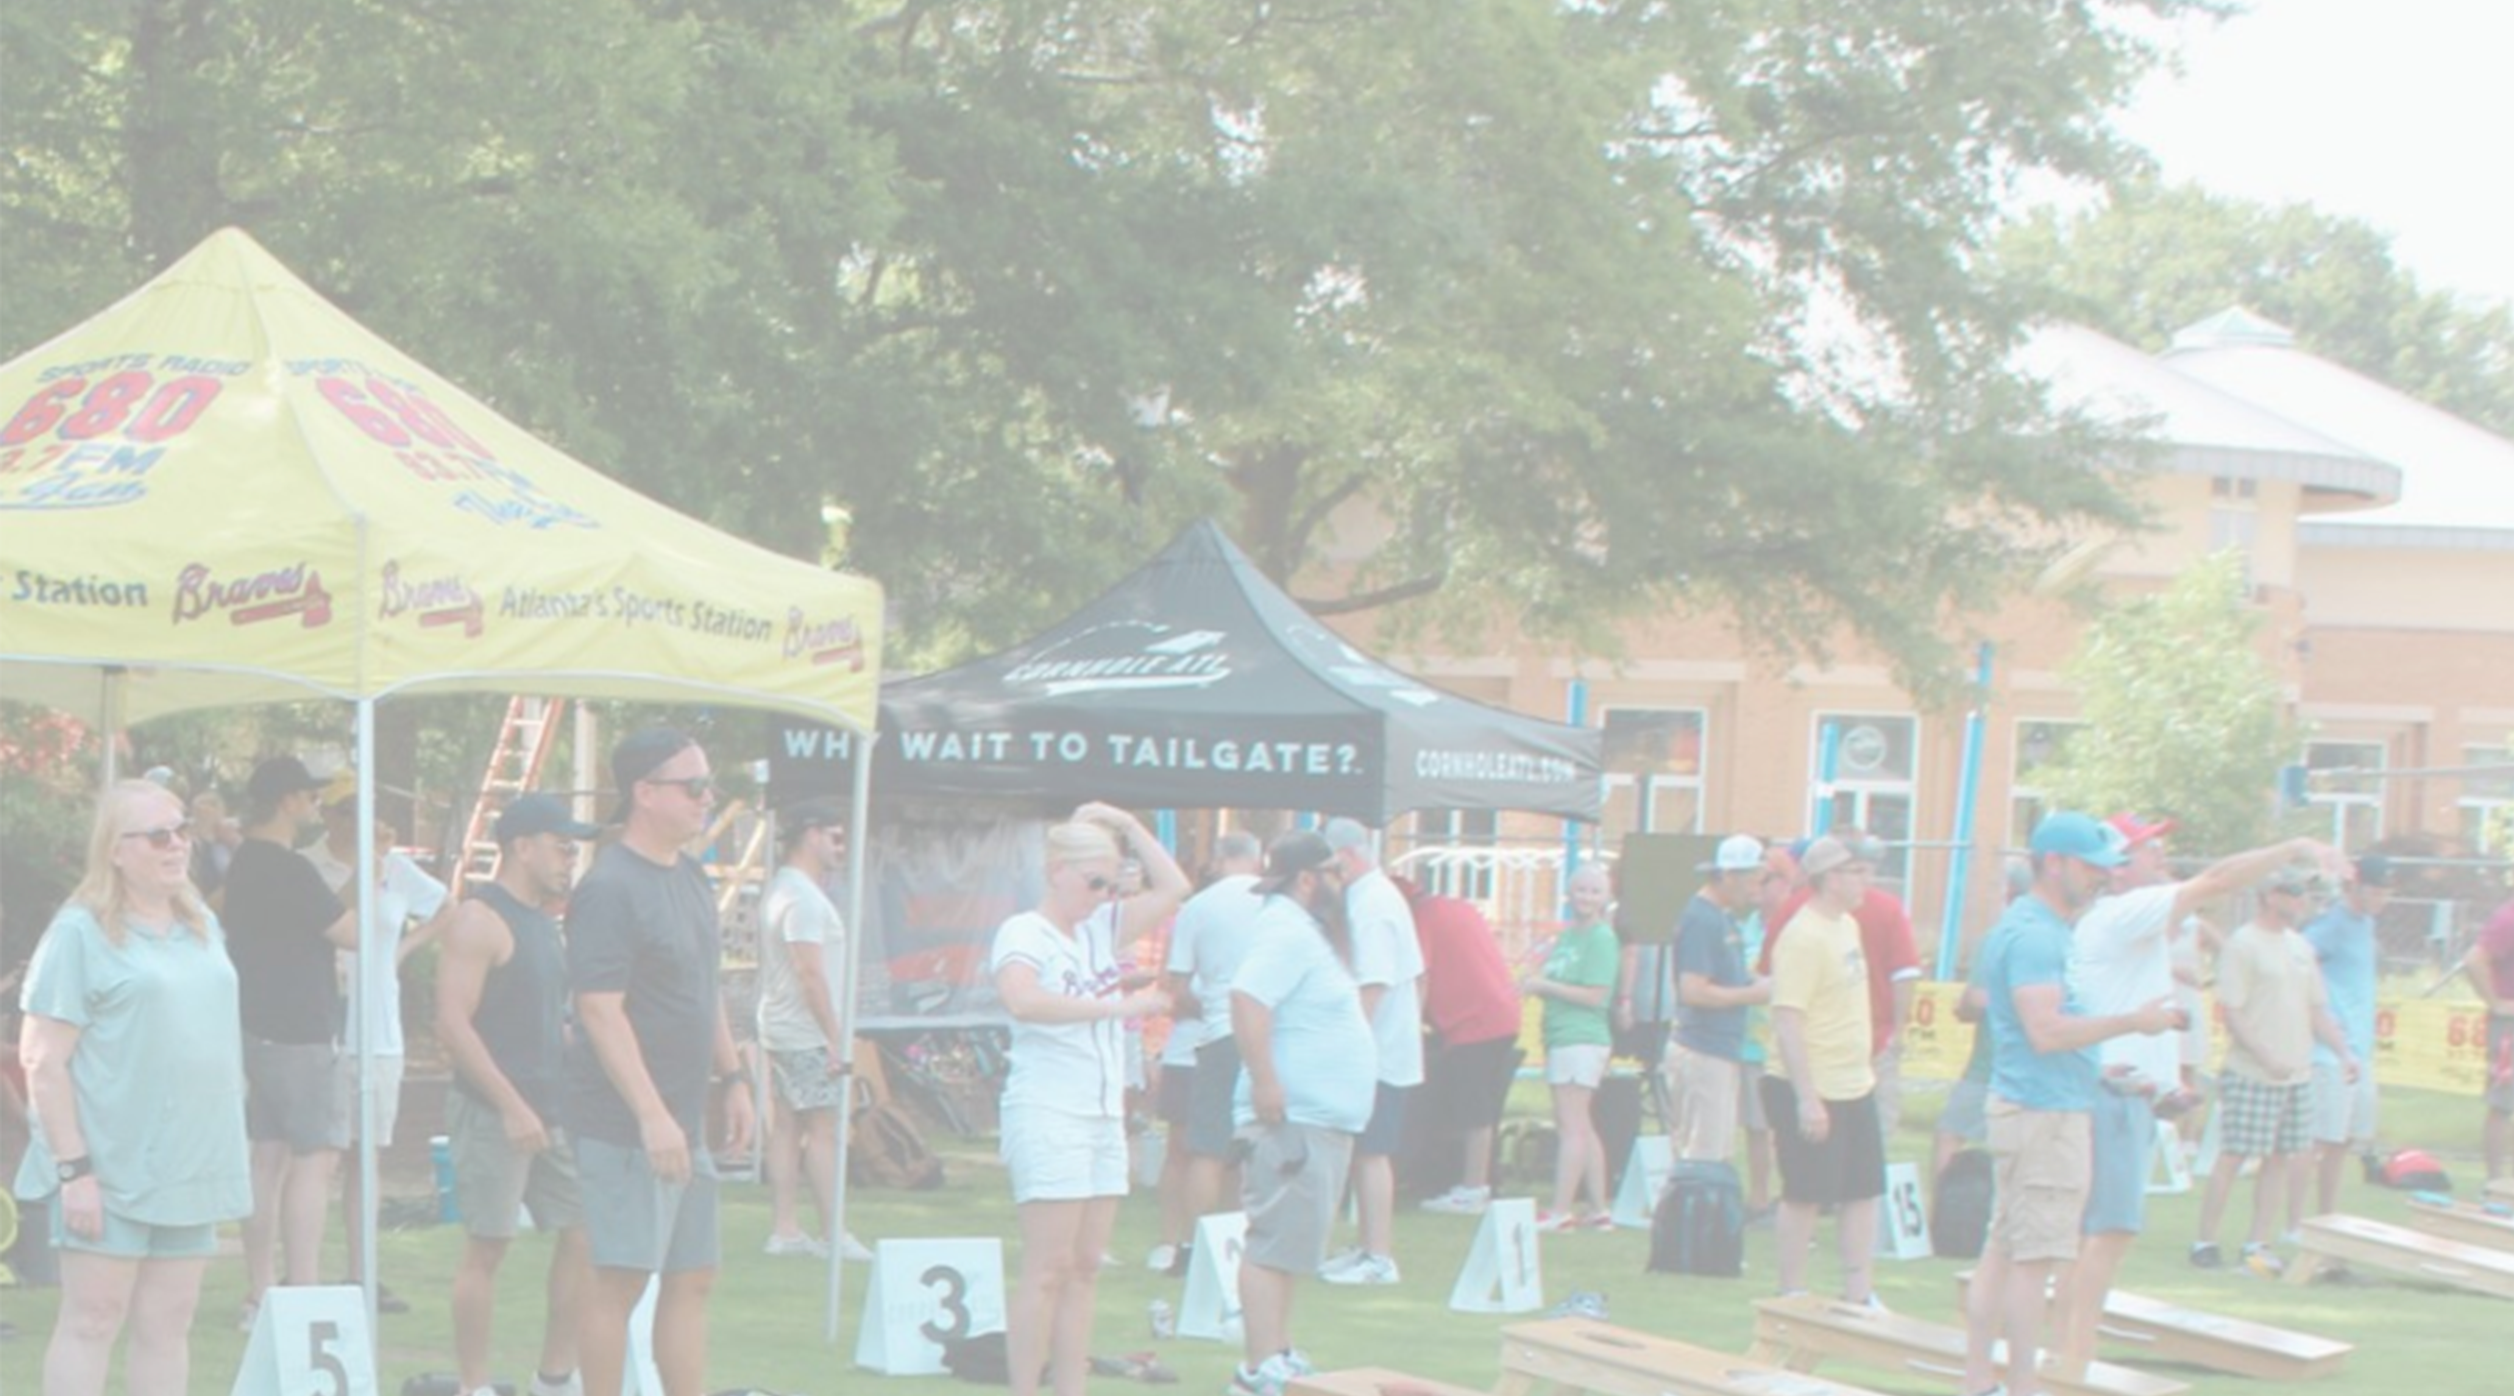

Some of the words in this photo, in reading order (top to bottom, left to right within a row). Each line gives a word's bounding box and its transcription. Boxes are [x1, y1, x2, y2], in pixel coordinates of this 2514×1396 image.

[36, 352, 154, 383] SPORTS
[158, 355, 253, 377] RADIO
[0, 370, 223, 446] 680
[11, 570, 148, 606] Station
[172, 562, 306, 625] Braves
[499, 586, 609, 618] Atlanta's
[613, 586, 685, 628] Sports
[690, 601, 773, 633] Station
[902, 732, 1011, 760] WAIT
[1031, 732, 1087, 761] TO
[1108, 734, 1357, 773] TAILGATE?
[1893, 1182, 1923, 1238] 15
[1513, 1222, 1527, 1287] 1
[919, 1264, 971, 1344] 3
[309, 1321, 350, 1396] 5
